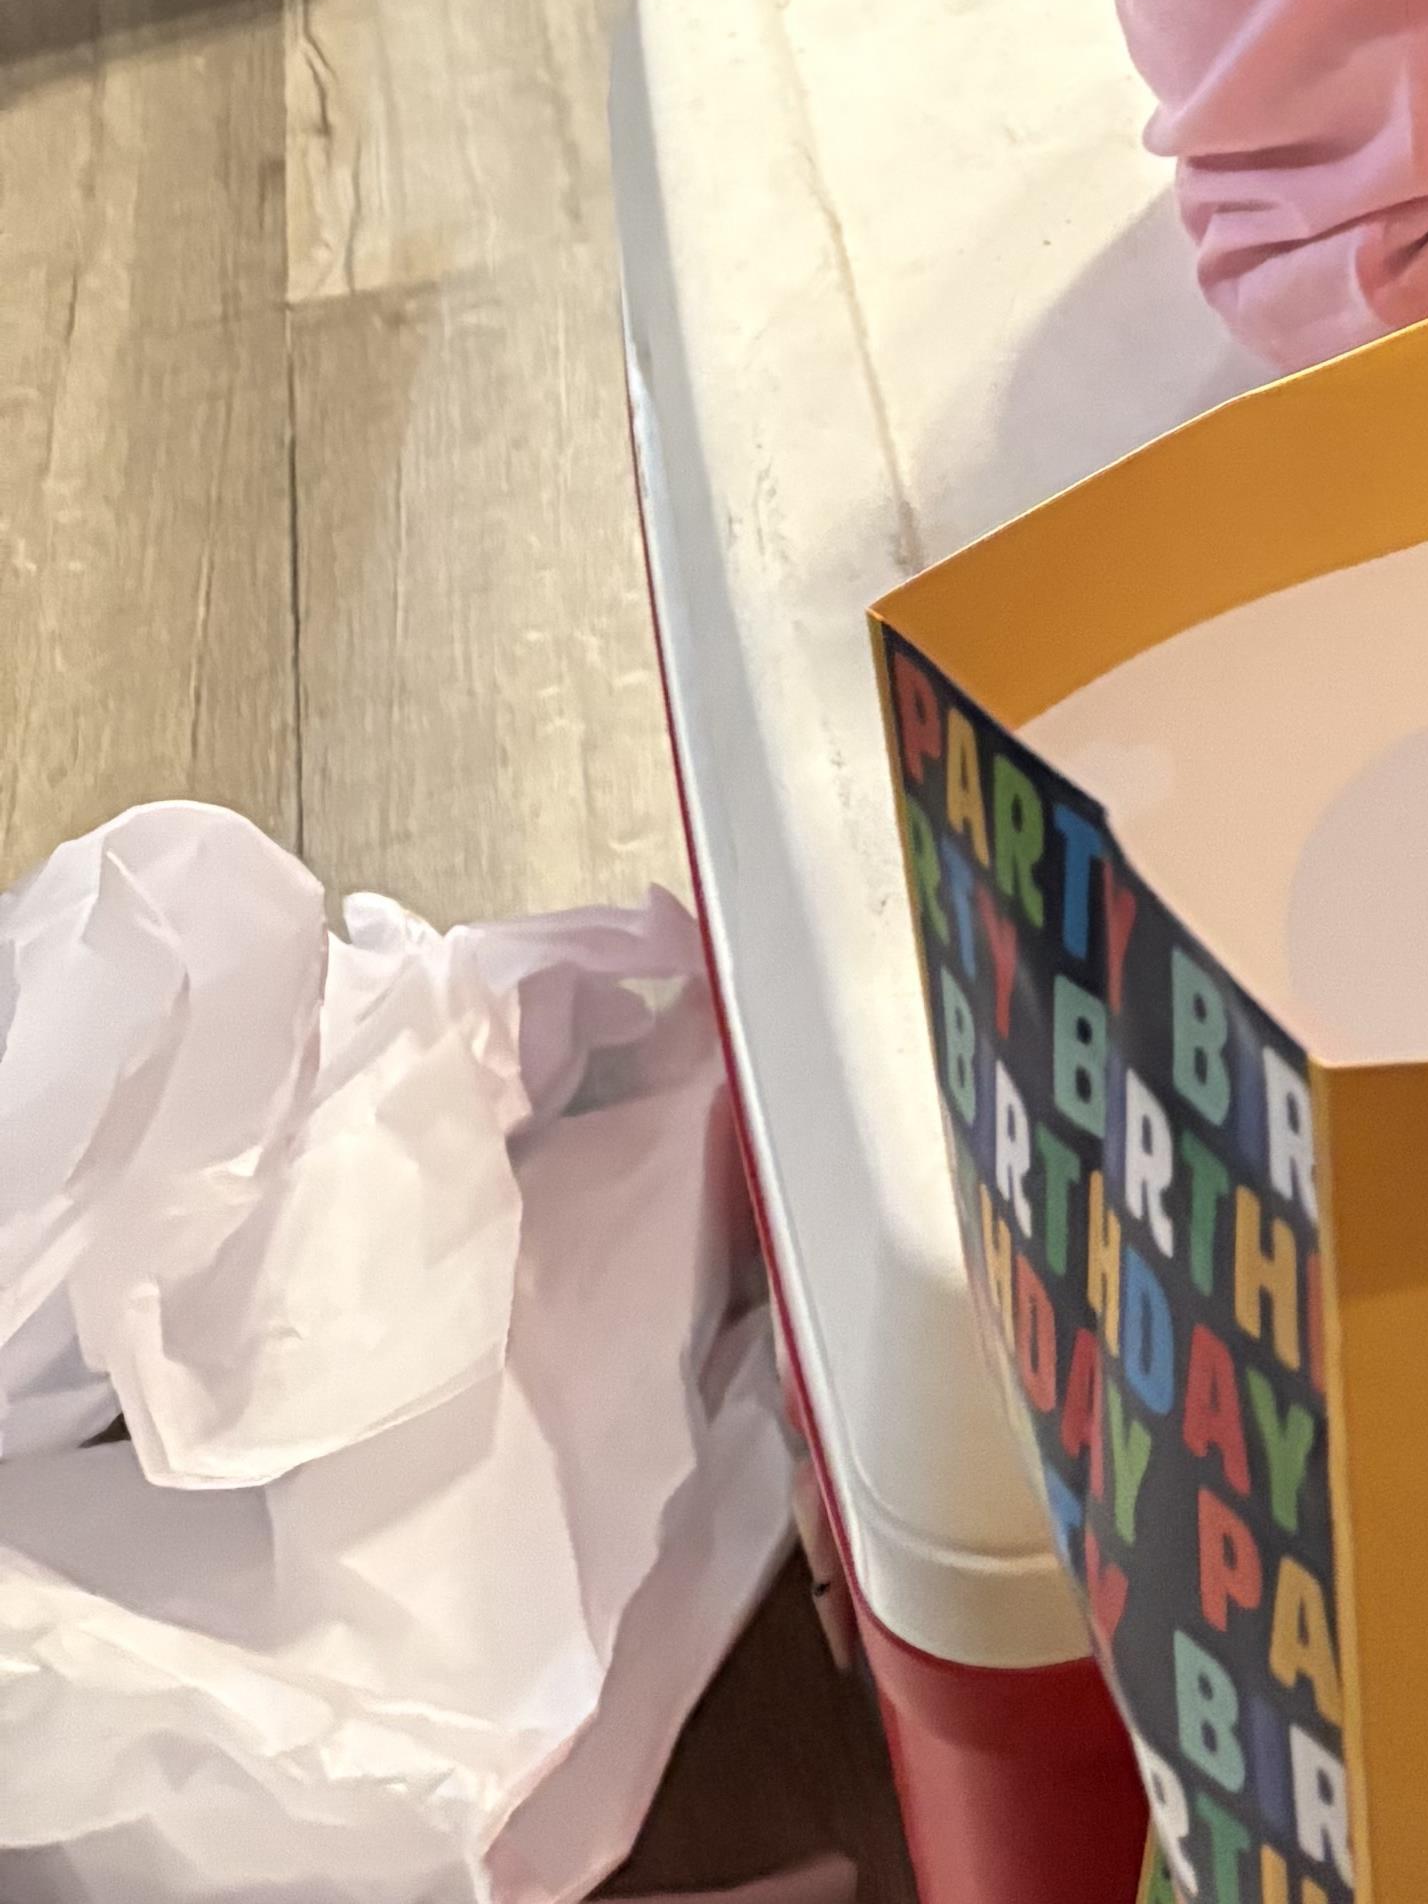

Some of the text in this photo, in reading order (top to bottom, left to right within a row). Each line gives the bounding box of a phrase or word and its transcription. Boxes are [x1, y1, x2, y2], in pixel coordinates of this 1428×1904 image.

[893, 649, 1137, 1018] PARTY
[941, 965, 1315, 1534] BIRTHDAY
[1053, 972, 1327, 1395] BIRTH
